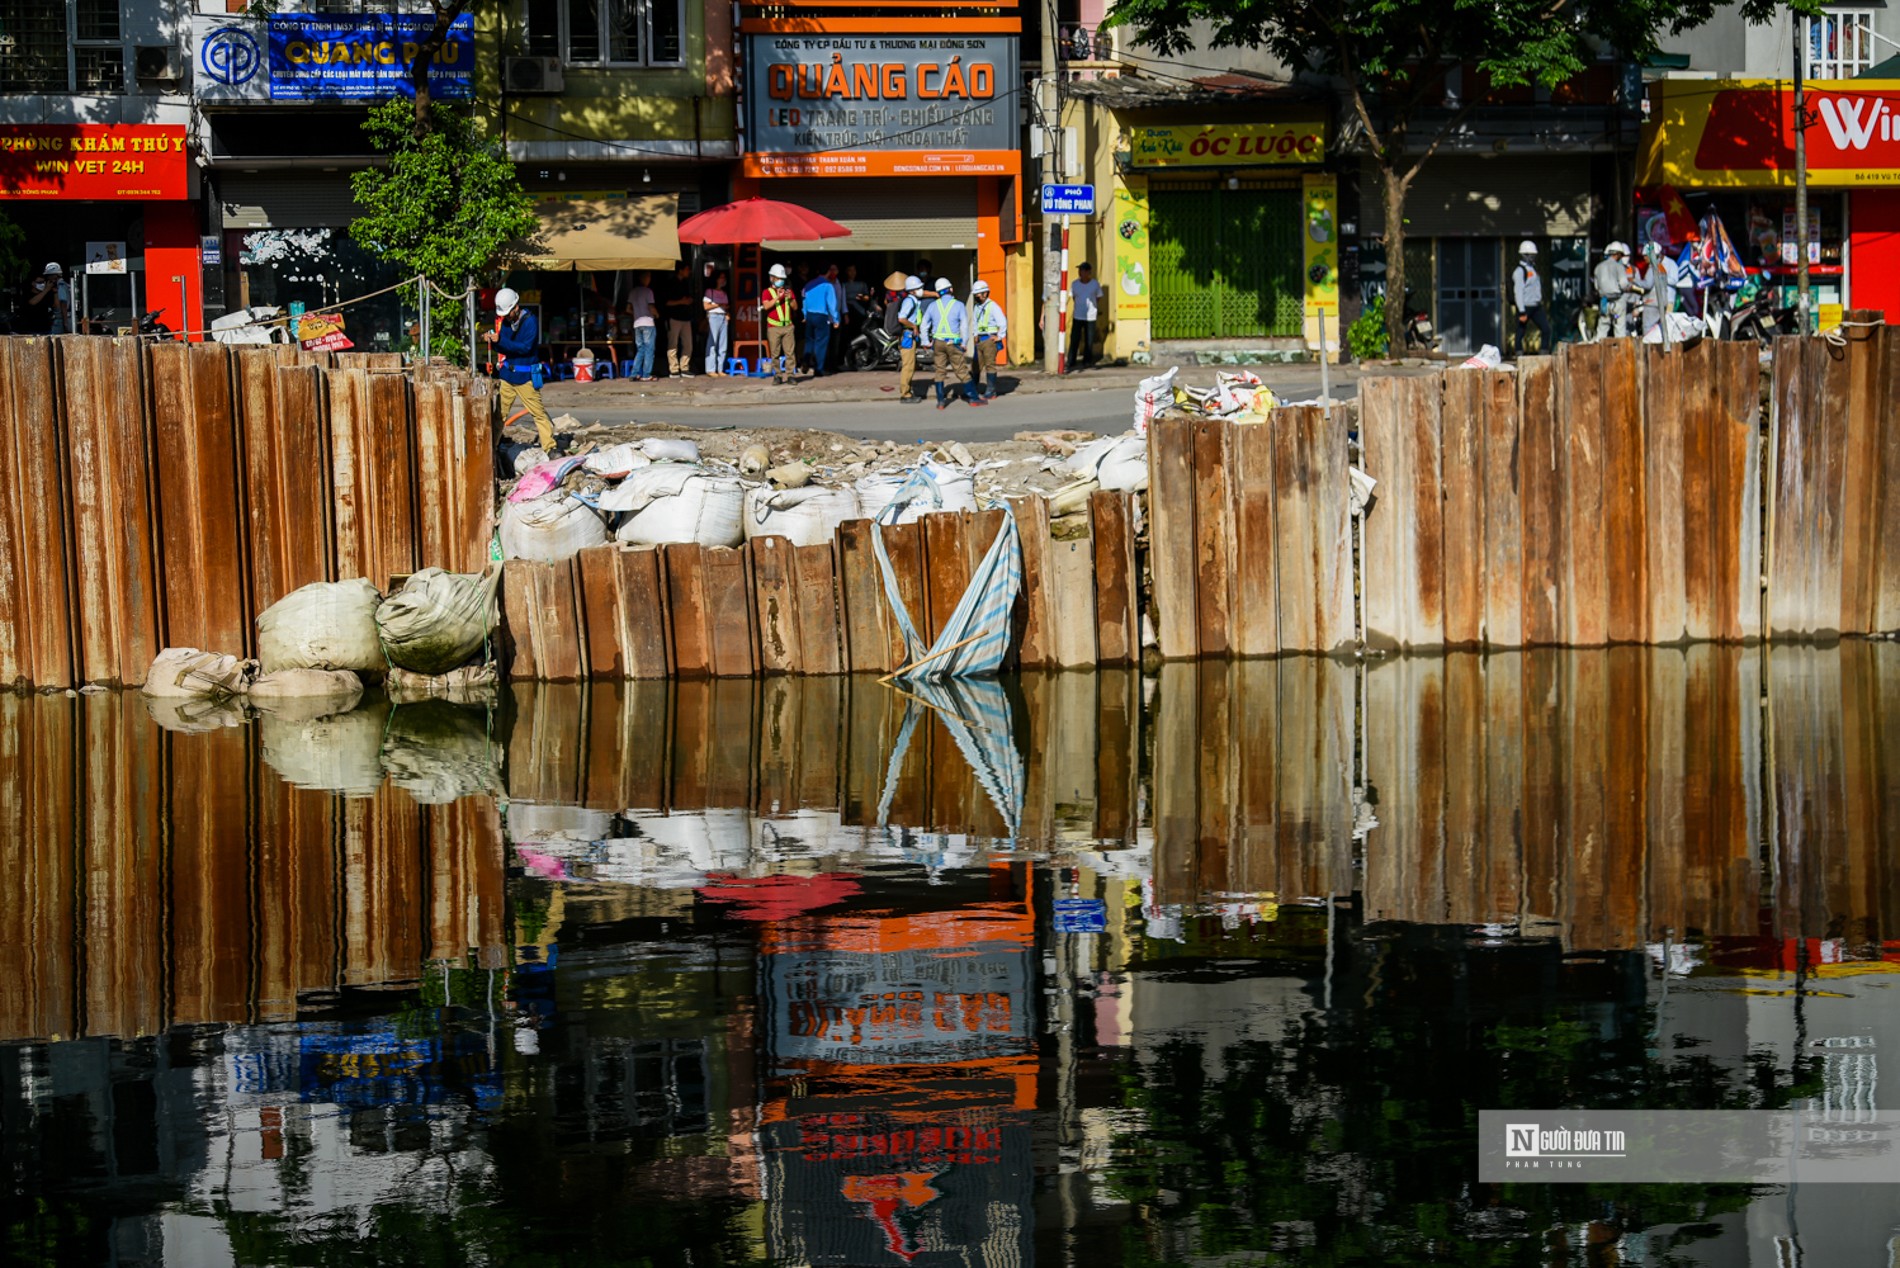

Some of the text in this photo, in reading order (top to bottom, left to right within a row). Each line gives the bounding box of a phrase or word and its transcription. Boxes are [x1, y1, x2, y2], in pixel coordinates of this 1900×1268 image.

[273, 20, 299, 31] CÔNG
[300, 22, 309, 31] TY
[311, 22, 332, 31] TNHH
[285, 38, 458, 65] QUANG PÚ
[775, 38, 800, 49] CÔNG
[803, 40, 815, 49] TY
[817, 40, 830, 49] CP
[854, 40, 867, 49] TƯ
[870, 40, 876, 49] &
[880, 39, 916, 49] THƯƠNG
[919, 40, 937, 51] MẠI
[966, 40, 986, 49] SƠN
[768, 52, 995, 100] QUẢNG CÁO
[769, 107, 801, 127] LED
[807, 109, 858, 126] TRANG
[862, 106, 888, 126] TRÍ
[900, 104, 946, 126] CHIẾU
[950, 104, 994, 126] SÁNG
[1, 133, 185, 152] PHÒNG KHÁM THÚ Y
[794, 129, 823, 146] KIẾN
[865, 130, 886, 148] NỘI
[896, 131, 935, 148] NGOẠI
[938, 128, 969, 146] THẤT
[1189, 128, 1231, 156] ỐC
[1236, 129, 1318, 159] LUỘC
[36, 160, 145, 174] WIN VET 24H
[1064, 188, 1082, 196] PHỐ
[1044, 198, 1054, 209] VŨ
[1074, 198, 1092, 210] PHAN
